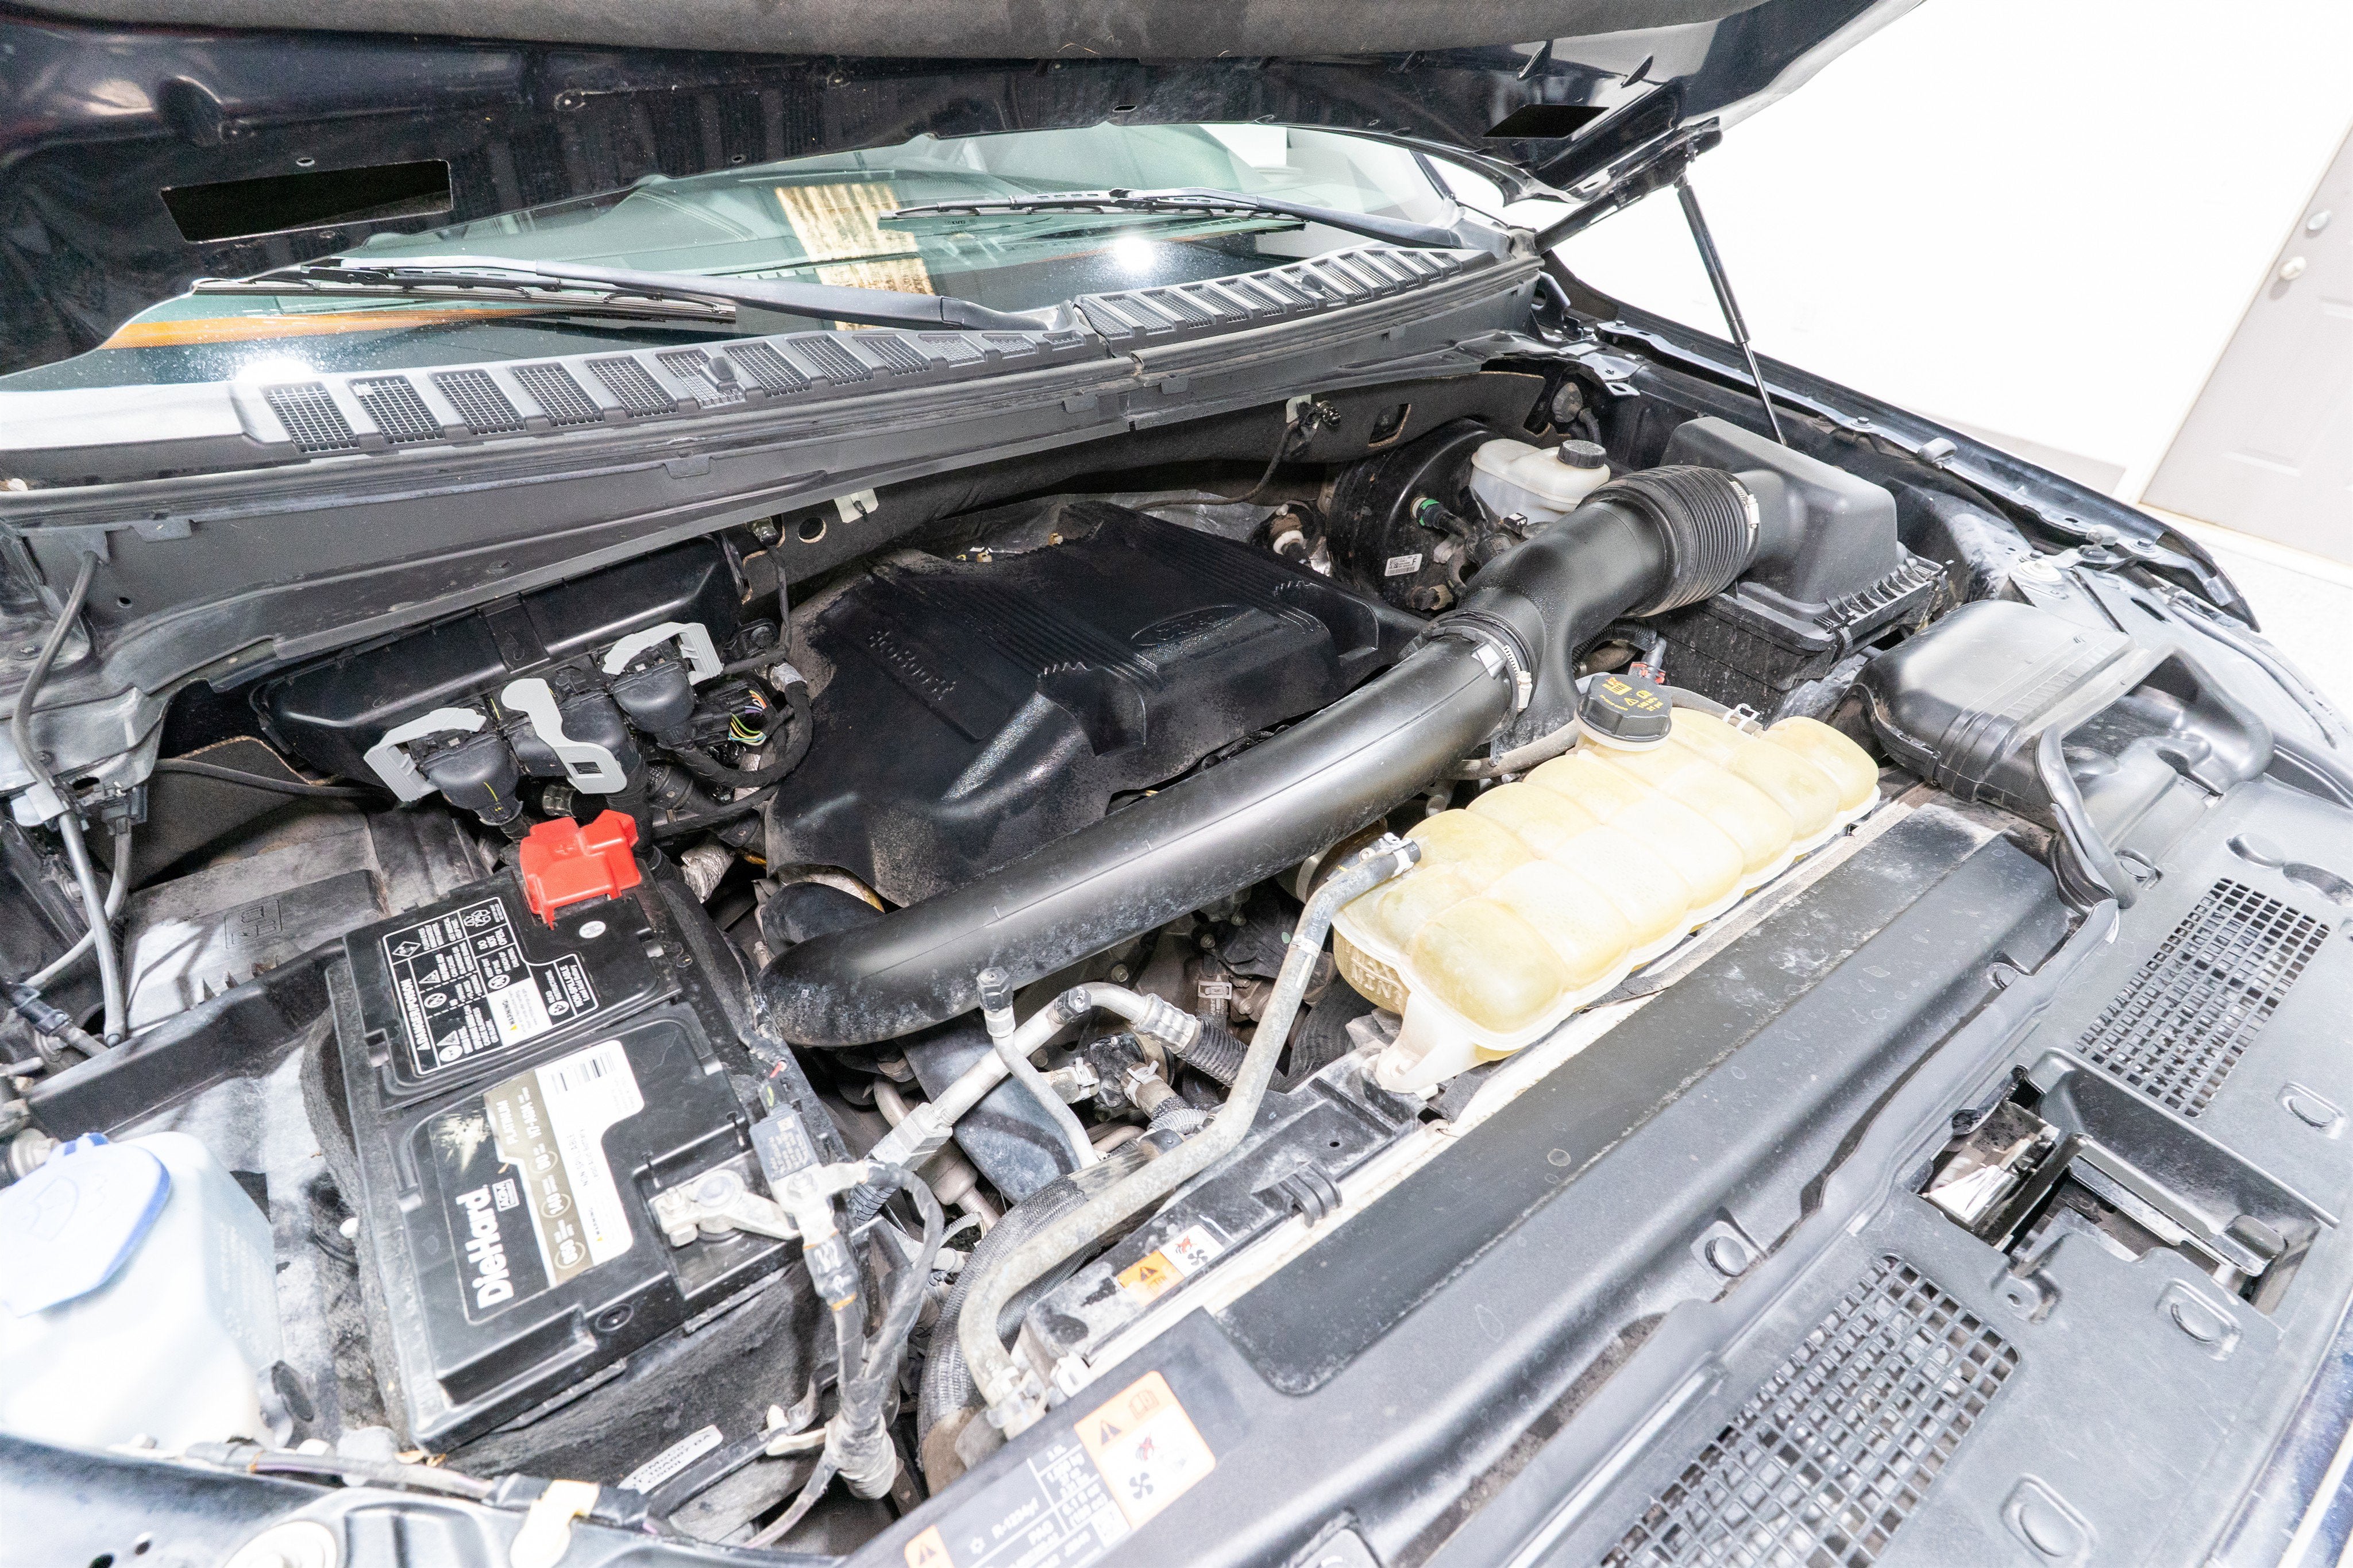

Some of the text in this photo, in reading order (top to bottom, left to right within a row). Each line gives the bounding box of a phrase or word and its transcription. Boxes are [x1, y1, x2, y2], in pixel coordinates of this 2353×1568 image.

[477, 939, 487, 949] DO
[486, 934, 497, 947] NOT
[481, 957, 489, 967] OUT
[560, 964, 583, 1007] NON-SPILLABLE
[579, 989, 589, 1001] Lead
[1352, 964, 1391, 999] MIN
[400, 978, 429, 1044] DANGER/POISON
[496, 1099, 519, 1145] PLATINUM
[495, 1183, 510, 1207] AGM
[546, 1192, 564, 1214] 140
[455, 1186, 514, 1309] DieHard
[633, 1445, 684, 1480] FoMoCo
